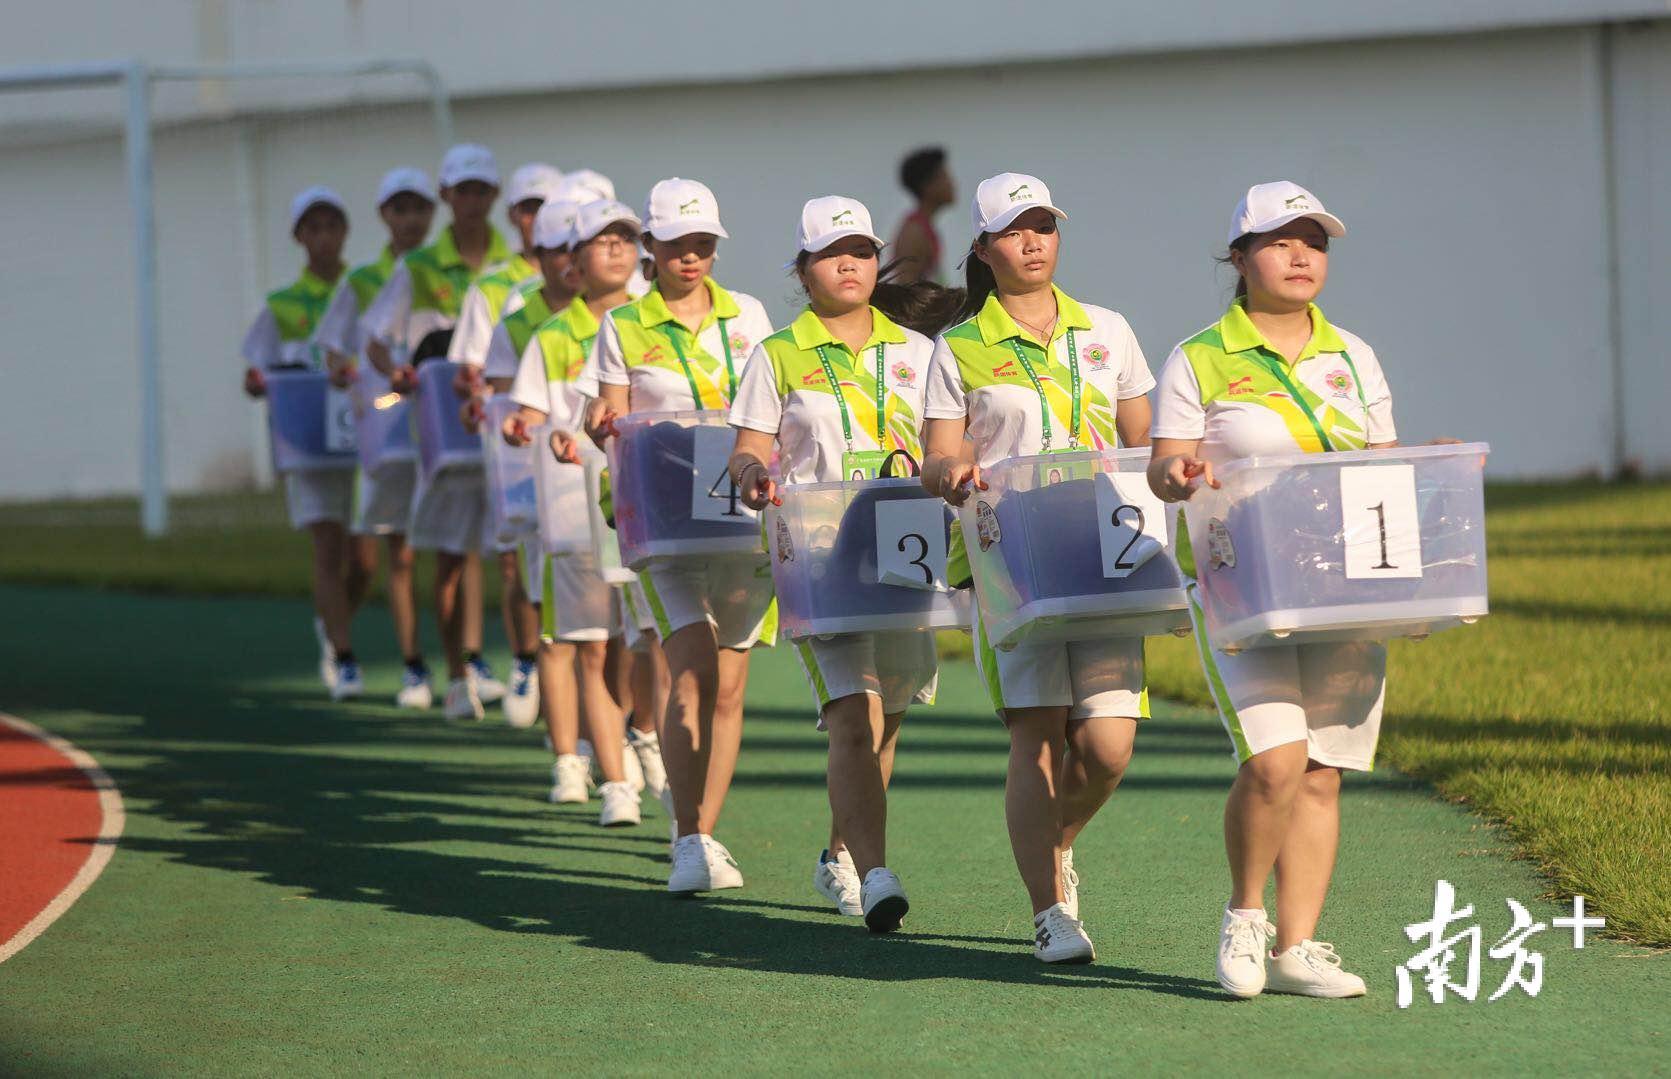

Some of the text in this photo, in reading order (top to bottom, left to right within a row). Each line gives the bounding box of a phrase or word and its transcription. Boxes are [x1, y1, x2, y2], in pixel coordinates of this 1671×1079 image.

[708, 466, 743, 516] 4
[898, 533, 933, 585] 3
[1111, 504, 1145, 570] 2
[1366, 501, 1399, 570] 1
